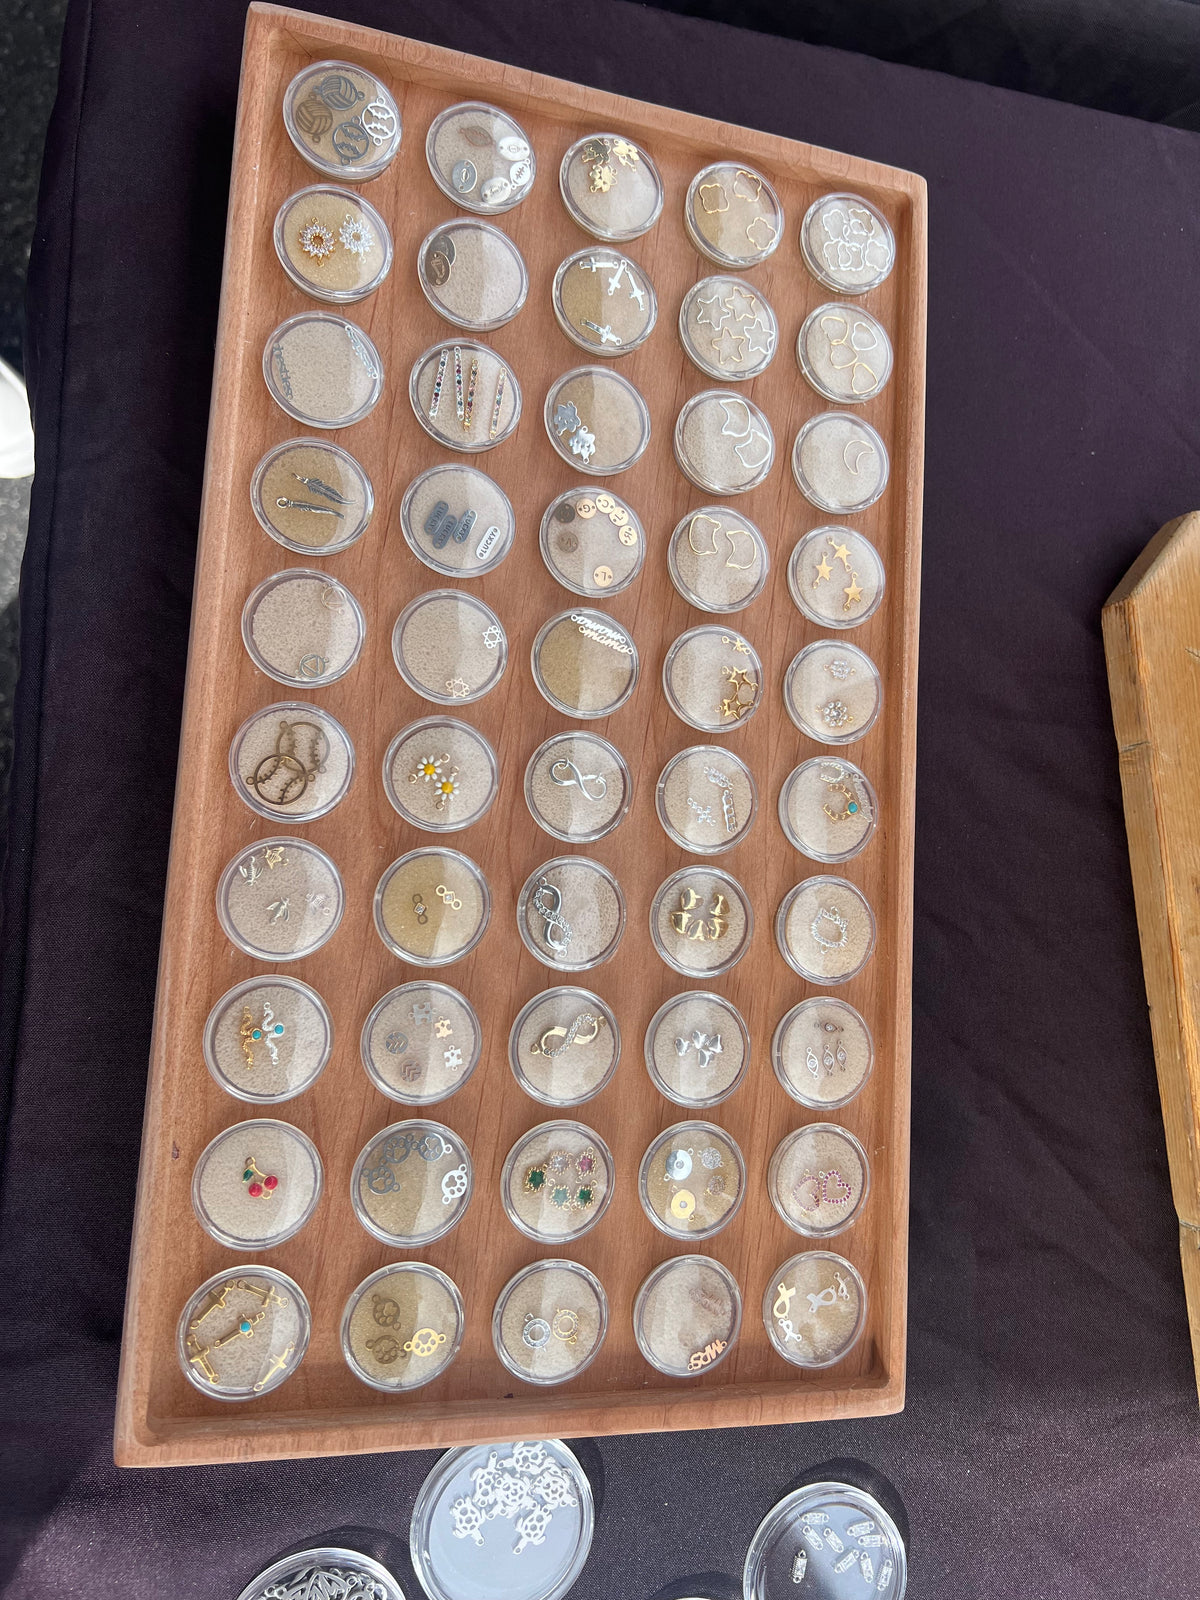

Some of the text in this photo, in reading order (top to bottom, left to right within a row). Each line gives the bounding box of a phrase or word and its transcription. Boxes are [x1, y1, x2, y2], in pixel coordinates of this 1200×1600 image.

[583, 504, 591, 513] G
[458, 514, 474, 538] LUCKY
[482, 530, 497, 554] LUCKY
[584, 628, 628, 653] mama
[690, 1339, 722, 1370] MRS
